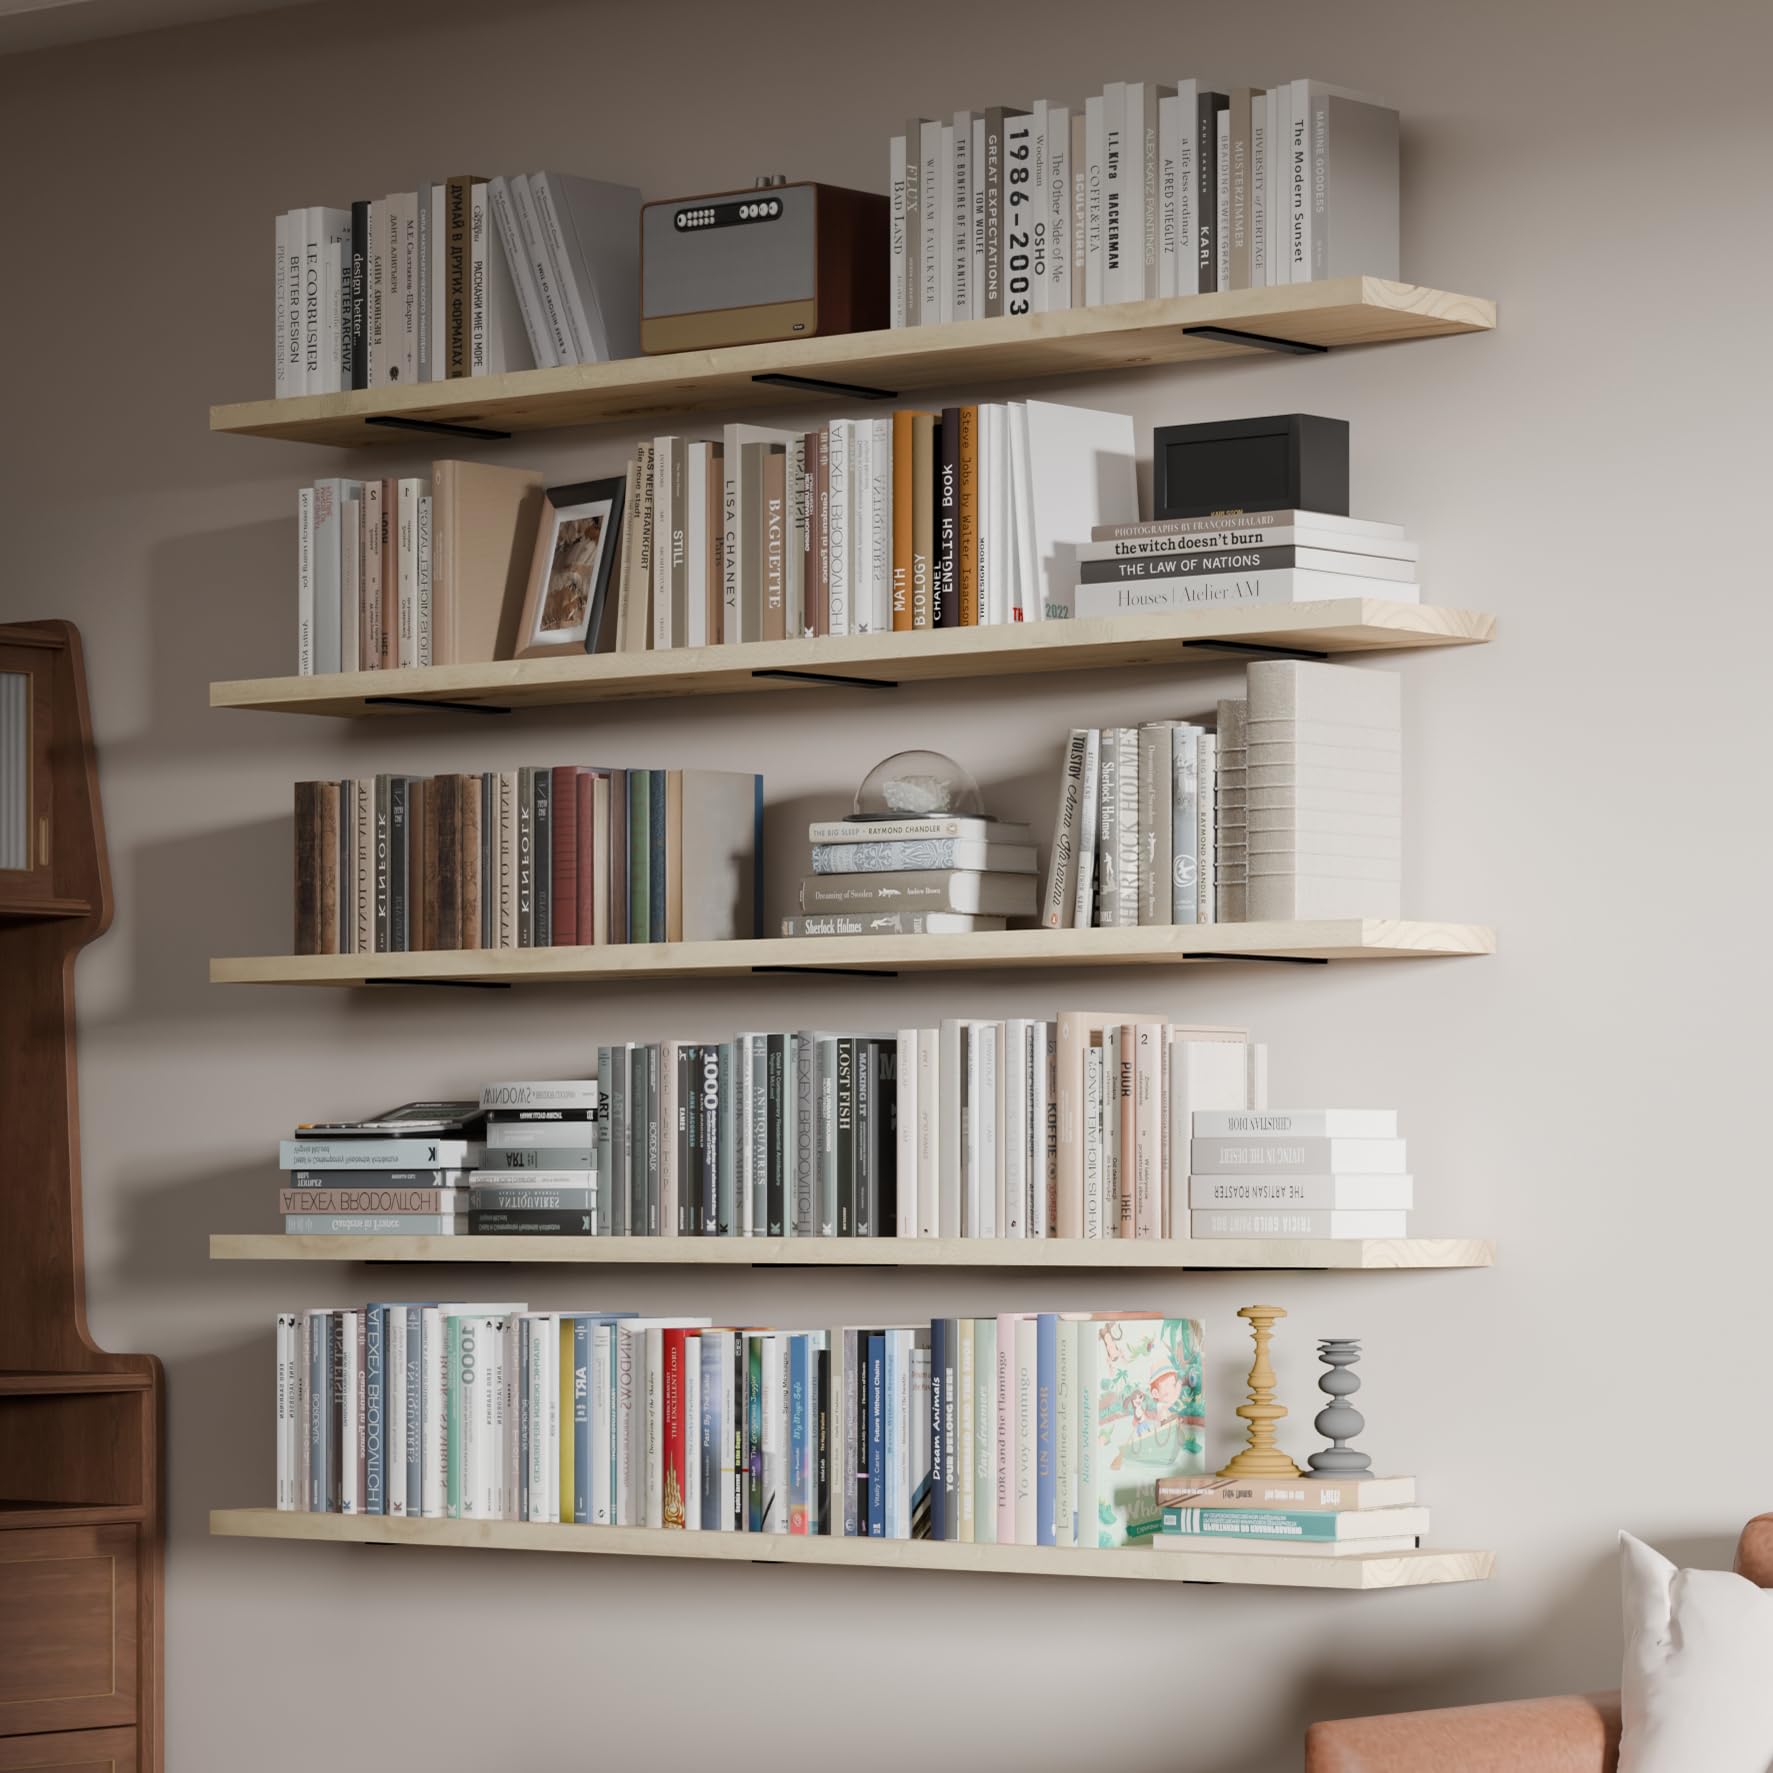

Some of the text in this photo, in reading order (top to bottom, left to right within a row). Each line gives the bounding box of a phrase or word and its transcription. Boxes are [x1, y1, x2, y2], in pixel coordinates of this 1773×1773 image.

[907, 164, 917, 212] FLUX
[1182, 149, 1191, 168] life
[1182, 172, 1191, 192] less
[957, 140, 965, 306] THE BONFIRE OF THE VANITIES
[988, 135, 997, 300] GREAT EXPECTATIONS
[1035, 135, 1044, 275] Woodman OSHO
[1052, 153, 1063, 283] The Other Side of Me
[1075, 174, 1084, 267] SCULPTURES
[1145, 128, 1155, 265] ALEX KATZ PAINTINGS
[1164, 160, 1173, 254] ALFRED STIEGLITZ
[1180, 195, 1191, 247] ordinary
[1235, 141, 1244, 248] MUSTERZIMMER
[1254, 196, 1263, 206] of
[1295, 120, 1303, 263] The Modern Sunset
[390, 214, 398, 246] ДАНТЕ
[926, 159, 934, 303] WILLIAM FAULKNER
[975, 192, 983, 255] TOM WOLFE
[1108, 193, 1119, 269] HACKERMAN
[1200, 226, 1209, 269] KARL
[290, 256, 299, 363] BETTER DESIGN
[306, 243, 318, 372] LE CORBUSIER
[374, 255, 382, 336] ВЕЧНОМУ МИРУ
[473, 261, 483, 309] РАССКАЖИ
[342, 267, 351, 373] BETTER ARCHVIZ
[473, 312, 483, 331] МНЕ
[473, 342, 483, 367] МОРЕ
[645, 474, 653, 503] NEUE
[961, 411, 971, 626] Steve Jobs by Walter Isaacson
[641, 507, 651, 571] FRANKFURT
[673, 530, 683, 567] STILL
[726, 480, 735, 608] LISA CHANEY
[769, 498, 781, 609] BAGUETTE
[942, 464, 953, 592] ENGLISH BOOK
[1115, 516, 1274, 536] PHOTOGRAPHS BY FRANÇOIS HALARD
[1115, 532, 1263, 555] the witch burn
[894, 568, 905, 611] MATH
[915, 554, 925, 626] BIOLOGY
[1118, 580, 1260, 607] Houses Atelier AM
[1119, 554, 1260, 576] THE LAW OF NATIONS
[1045, 603, 1069, 619] 2022
[868, 825, 940, 835] RAYMOND CHANDLER
[1052, 737, 1085, 906] TOLSTOY Anna Karenina
[1102, 762, 1114, 840] Sherlock Holmes
[805, 918, 862, 934] Sherlock Holmes
[599, 1092, 609, 1120] ART
[704, 1052, 718, 1109] 1000
[840, 1043, 850, 1129] LOST FISH
[859, 1104, 866, 1117] IT
[799, 1036, 810, 1223] ALEXEY BRODOVITCH
[1048, 1102, 1057, 1159] KOFFIE
[1228, 1117, 1292, 1130] CHRISTIAN DIOR
[1219, 1147, 1304, 1164] LIVING IN THE DESERT
[1121, 1193, 1131, 1221] THEE
[1214, 1185, 1304, 1199] THE ARTISAN ROASTER
[932, 1377, 941, 1480] Dream Animals
[1019, 1368, 1029, 1499] Yo voy conmigo
[1040, 1386, 1048, 1477] UN AMOR
